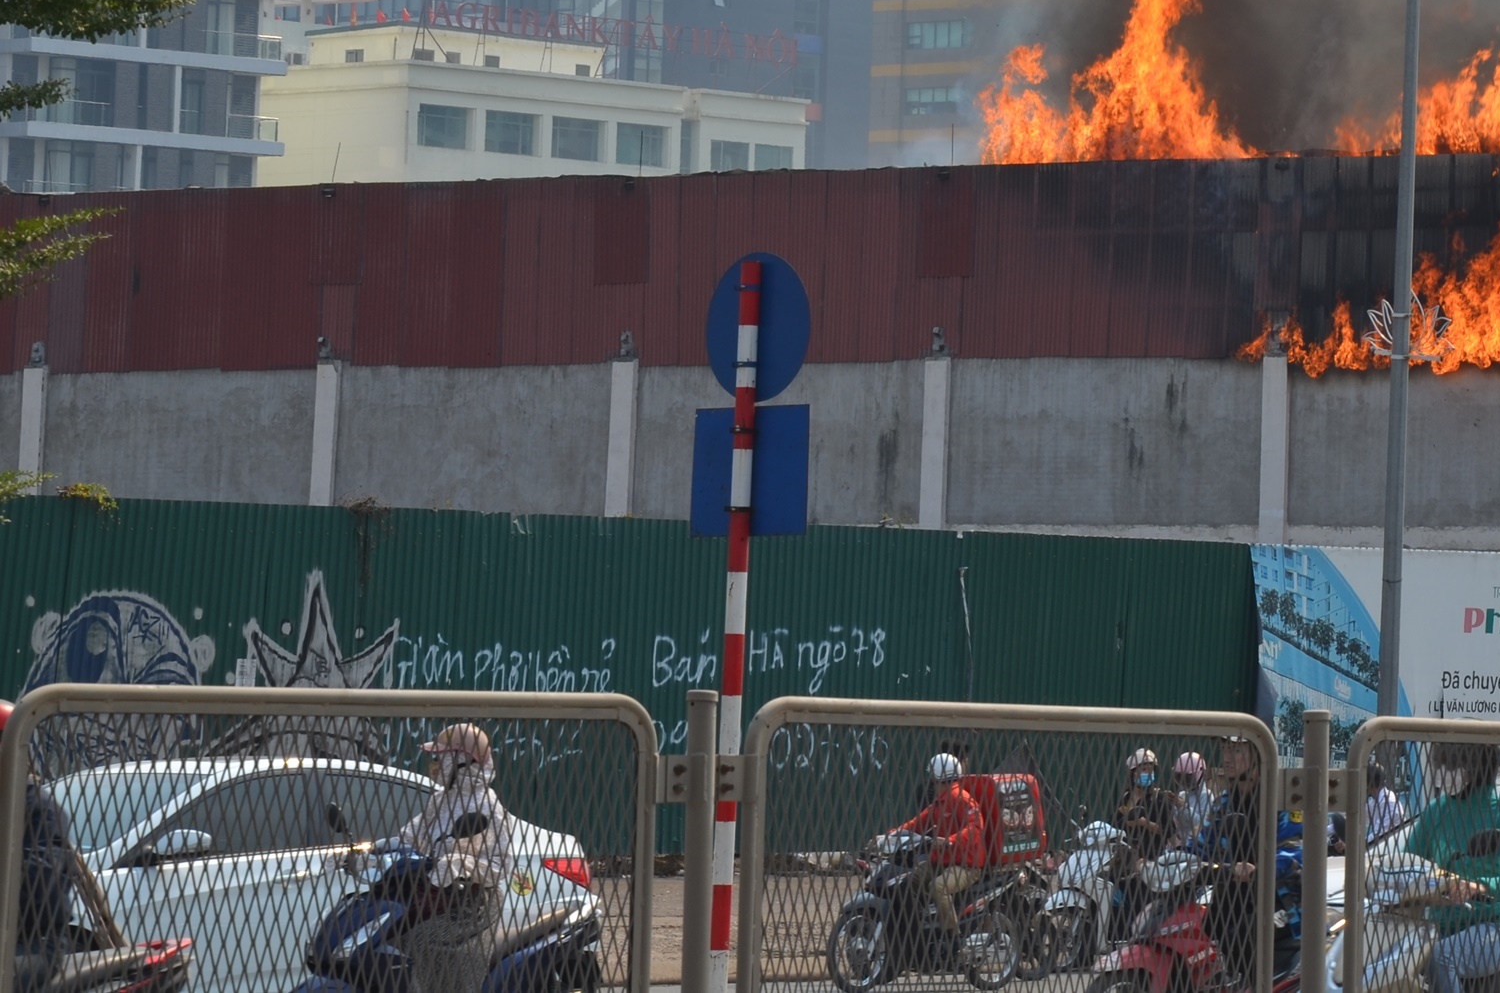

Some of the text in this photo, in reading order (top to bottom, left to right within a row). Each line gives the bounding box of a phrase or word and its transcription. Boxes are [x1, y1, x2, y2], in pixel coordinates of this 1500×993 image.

[431, 0, 798, 68] AGRIBANK TÂY HÀ NỘI
[1441, 670, 1460, 690] Đã
[1446, 698, 1464, 712] VĂN
[1466, 699, 1497, 713] LƯƠNG
